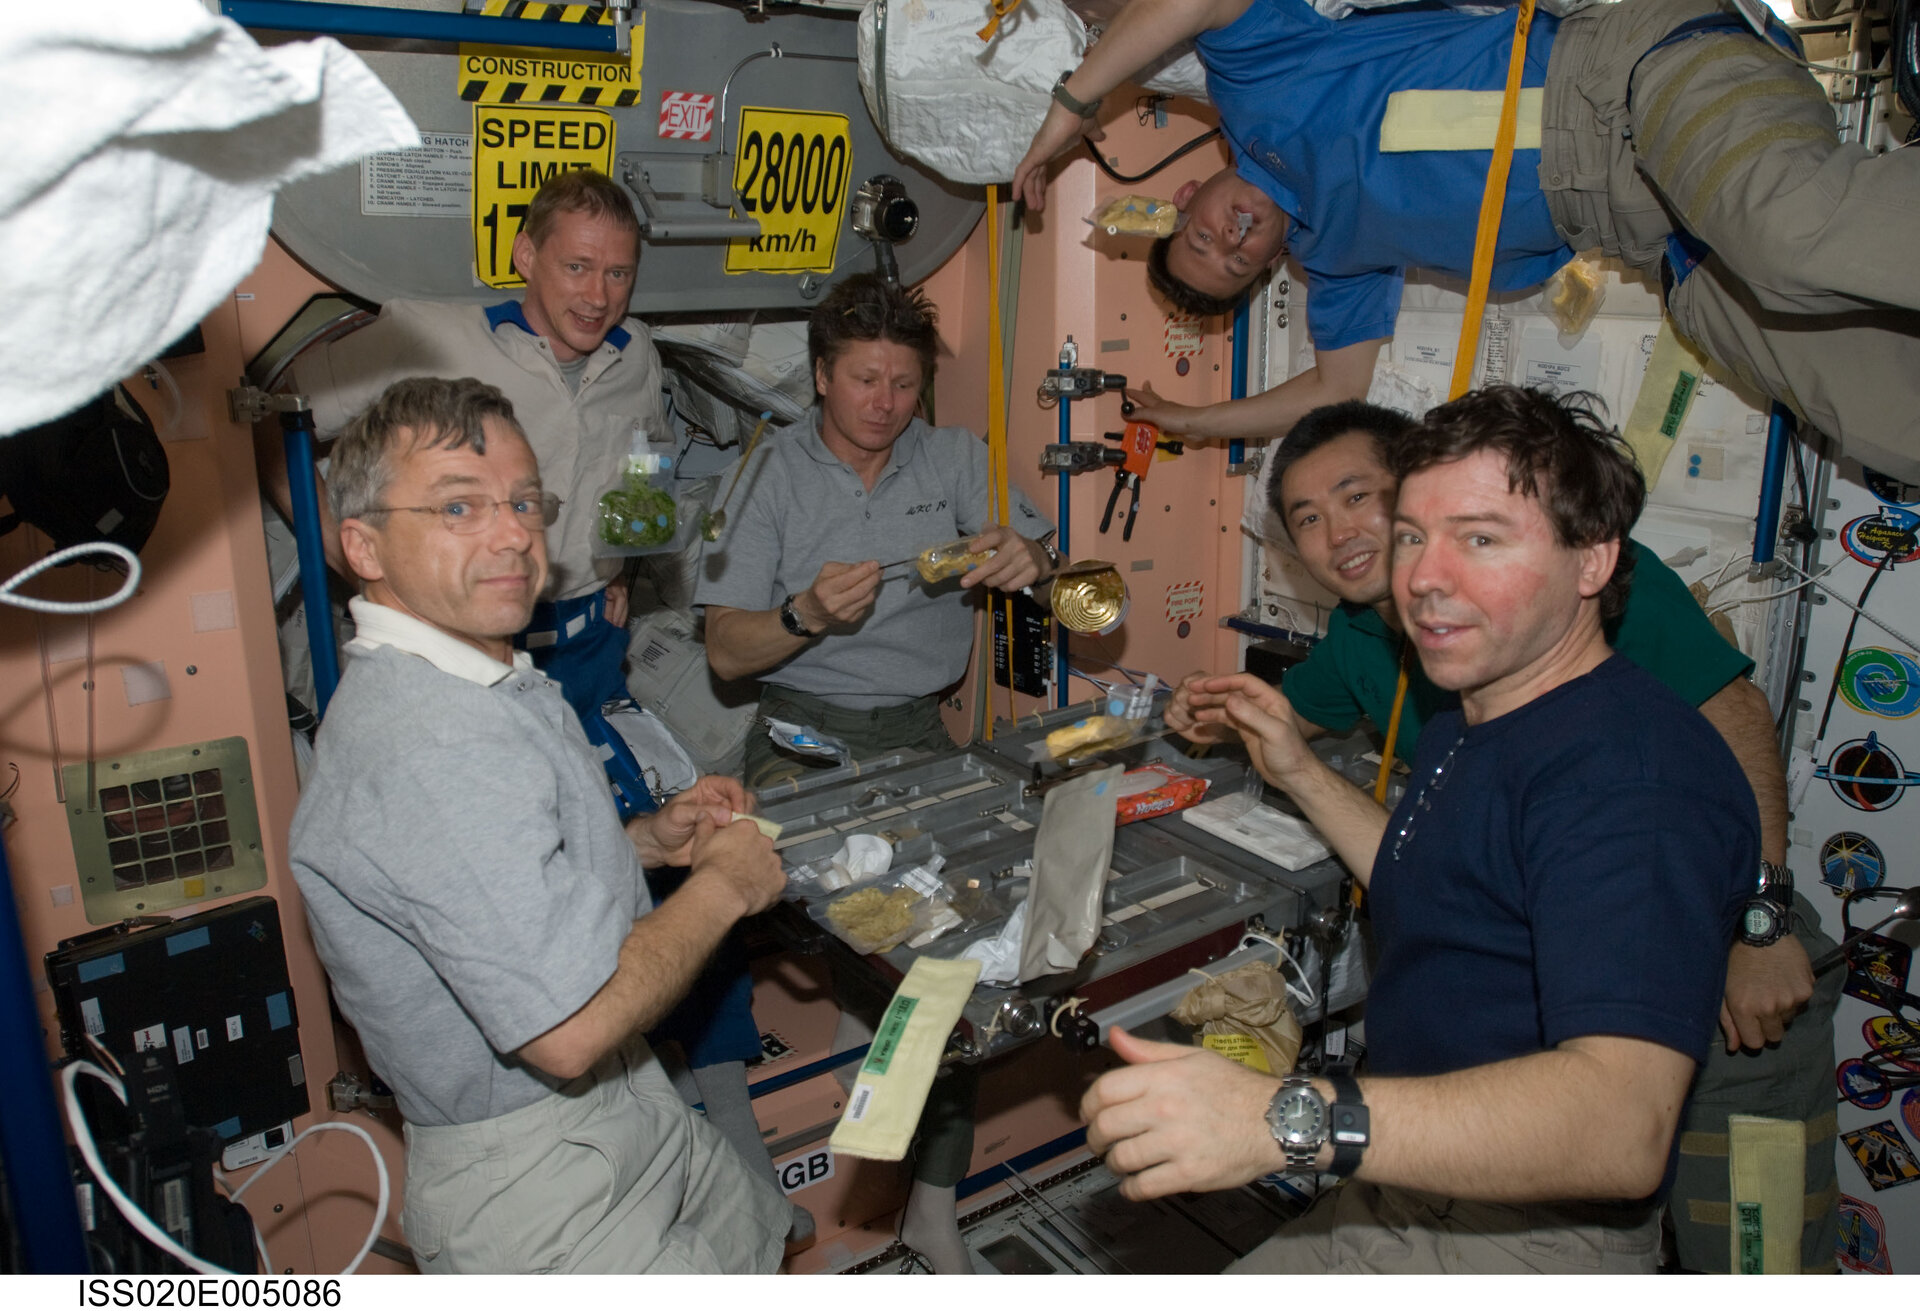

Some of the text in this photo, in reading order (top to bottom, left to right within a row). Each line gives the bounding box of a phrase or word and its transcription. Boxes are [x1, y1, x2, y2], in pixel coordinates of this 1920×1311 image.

[467, 56, 631, 83] CONSTRUCTION
[668, 103, 706, 130] EXIT
[435, 138, 468, 146] HATCH
[482, 118, 606, 150] SPEED
[741, 130, 845, 214] 28000
[749, 228, 816, 253] km/h
[776, 1152, 829, 1190] GB
